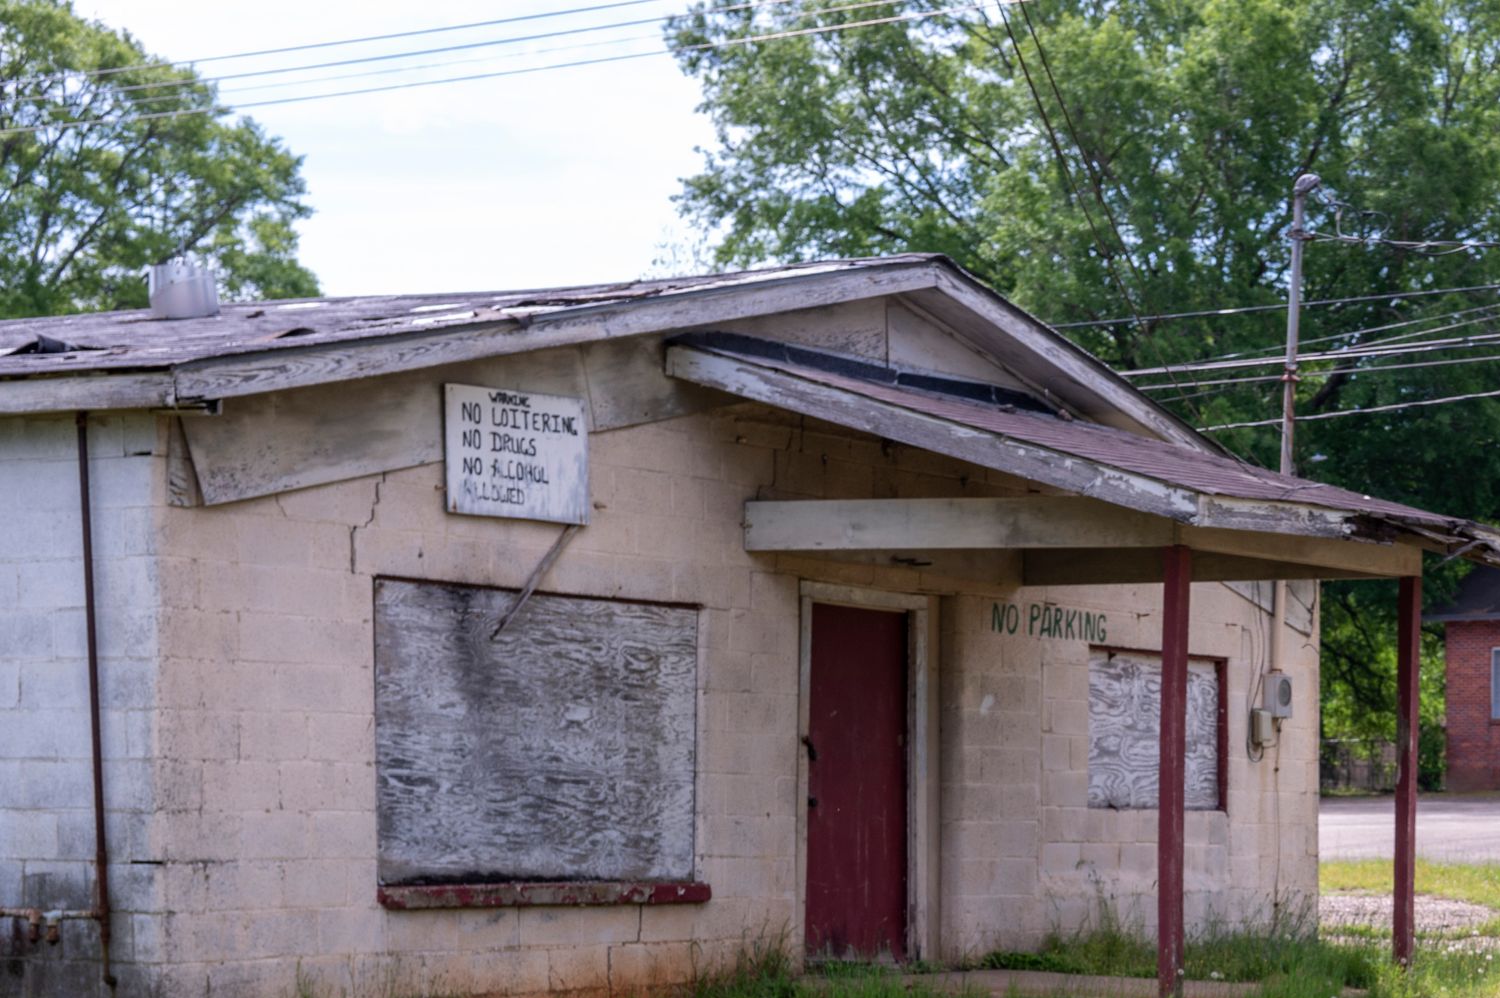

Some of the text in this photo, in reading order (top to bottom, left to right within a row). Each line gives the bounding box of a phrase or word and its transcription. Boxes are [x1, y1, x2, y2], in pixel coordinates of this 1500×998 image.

[488, 391, 531, 408] WARNING
[462, 402, 578, 436] NO LOITERING
[462, 429, 537, 457] NO DRUGS
[462, 457, 549, 484] NO ALCOHOL
[991, 602, 1107, 642] NO PARKING
